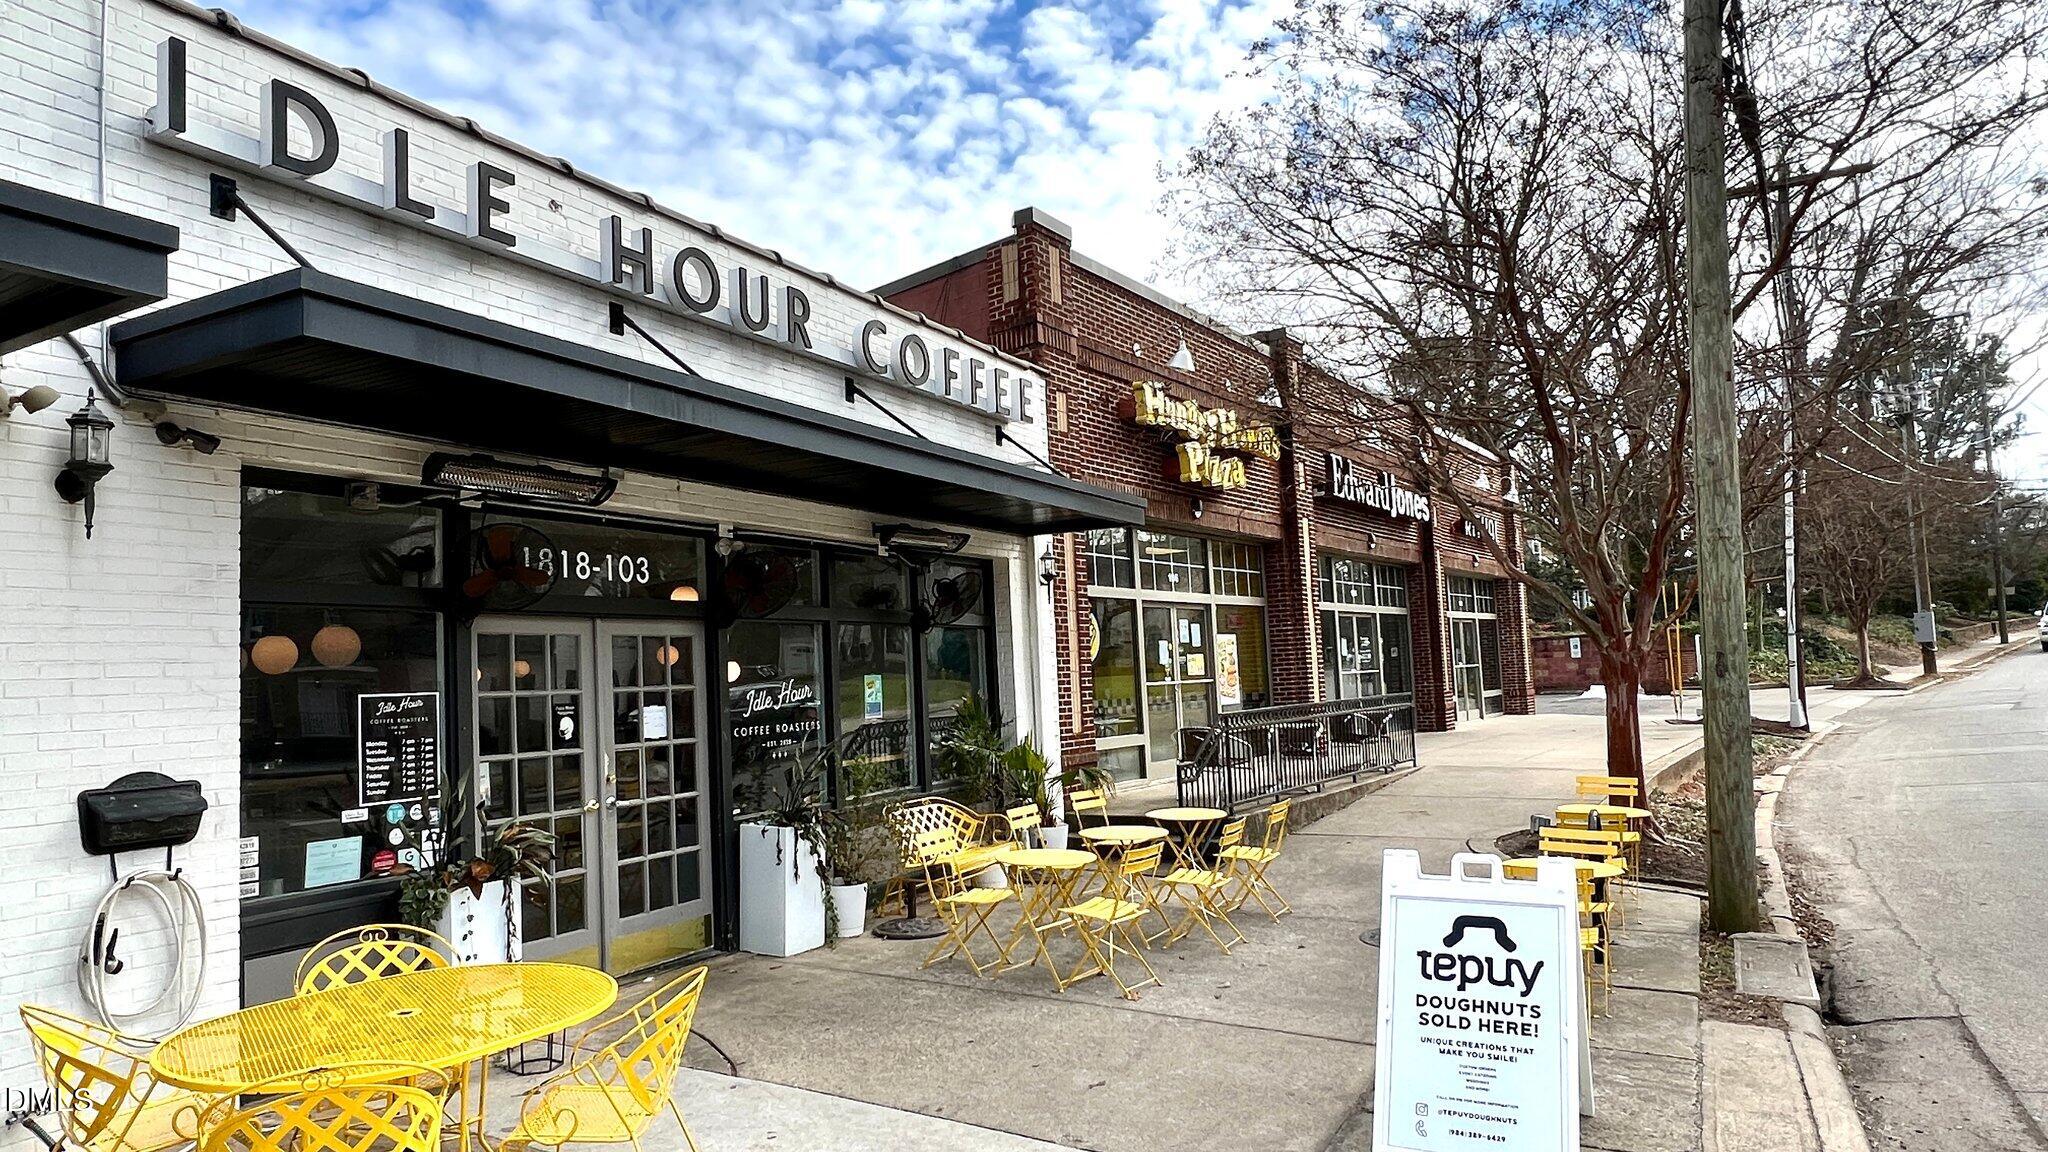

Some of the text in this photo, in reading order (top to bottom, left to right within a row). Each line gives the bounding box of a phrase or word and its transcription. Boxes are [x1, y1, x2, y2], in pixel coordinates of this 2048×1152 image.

[160, 36, 1034, 424] IDLE HOUR COFFEE
[1176, 441, 1247, 490] Pizza
[523, 546, 650, 584] 1818-103
[376, 697, 423, 716] Idle Hour
[742, 678, 813, 718] Idle Hour
[734, 720, 821, 737] COFFEE ROASTERS
[405, 851, 414, 861] G
[1417, 950, 1544, 997] tepuy
[1416, 994, 1541, 1019] DOUGHNUTS
[1418, 1012, 1539, 1038] SOLD HERE!
[1420, 1036, 1534, 1055] UNIQUE CREATIONS THAT
[1439, 1048, 1518, 1063] MAKE YOU SMILE!
[1438, 1109, 1518, 1125] @TEPUYDOUGHNUTS
